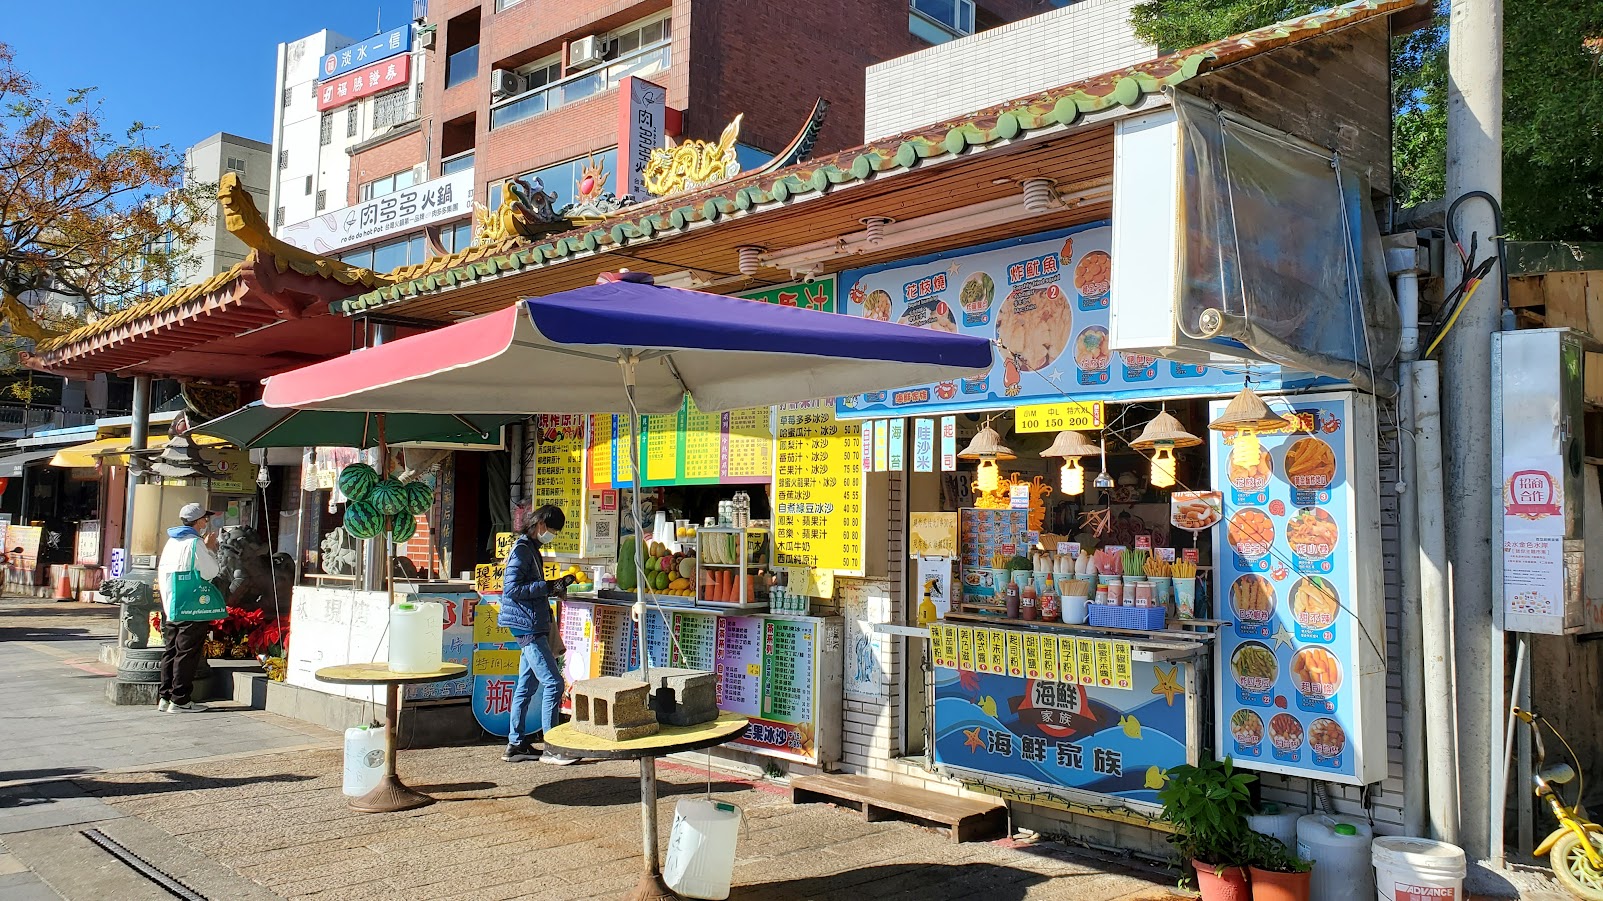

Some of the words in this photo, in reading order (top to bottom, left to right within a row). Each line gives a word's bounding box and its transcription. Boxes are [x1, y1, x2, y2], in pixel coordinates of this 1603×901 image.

[342, 31, 400, 67] 淡水一信
[337, 63, 396, 97] 福勝證券
[360, 183, 452, 229] 肉多多火鍋
[1010, 256, 1057, 282] 炸魷魚
[906, 273, 946, 300] 花枝燒
[780, 413, 829, 426] 草莓多多冰沙
[1022, 419, 1039, 429] 100
[1045, 418, 1063, 428] 150
[1069, 416, 1088, 426] 200
[1048, 407, 1060, 416] 中L
[891, 426, 902, 469] 海苔
[917, 426, 931, 470] 哇沙米
[943, 424, 954, 469] 起司
[779, 490, 811, 500] 香蕉冰沙
[1519, 478, 1543, 489] 招商
[1520, 490, 1545, 502] 合作
[779, 502, 834, 514] 自煮綠豆冰沙
[777, 541, 810, 552] 木瓜牛奶
[777, 554, 818, 565] 西瓜純原汁
[545, 564, 557, 579] 汁
[493, 582, 502, 590] 小
[1300, 612, 1332, 624] 甜不辣
[961, 630, 970, 661] 美乃滋
[977, 631, 986, 663] 泰式醬
[992, 633, 1001, 664] 芥末粉
[1010, 635, 1018, 667] 起司粉
[1026, 636, 1036, 669] 胡椒鹽
[1044, 637, 1052, 671] 海苔粉
[1080, 641, 1090, 675] 咖哩粉
[1036, 681, 1077, 710] 海鮮
[1301, 681, 1333, 694] 起司條
[1041, 709, 1072, 727] 家族
[987, 730, 1123, 778] 海鮮家族
[1406, 885, 1453, 897] ADVANCE
